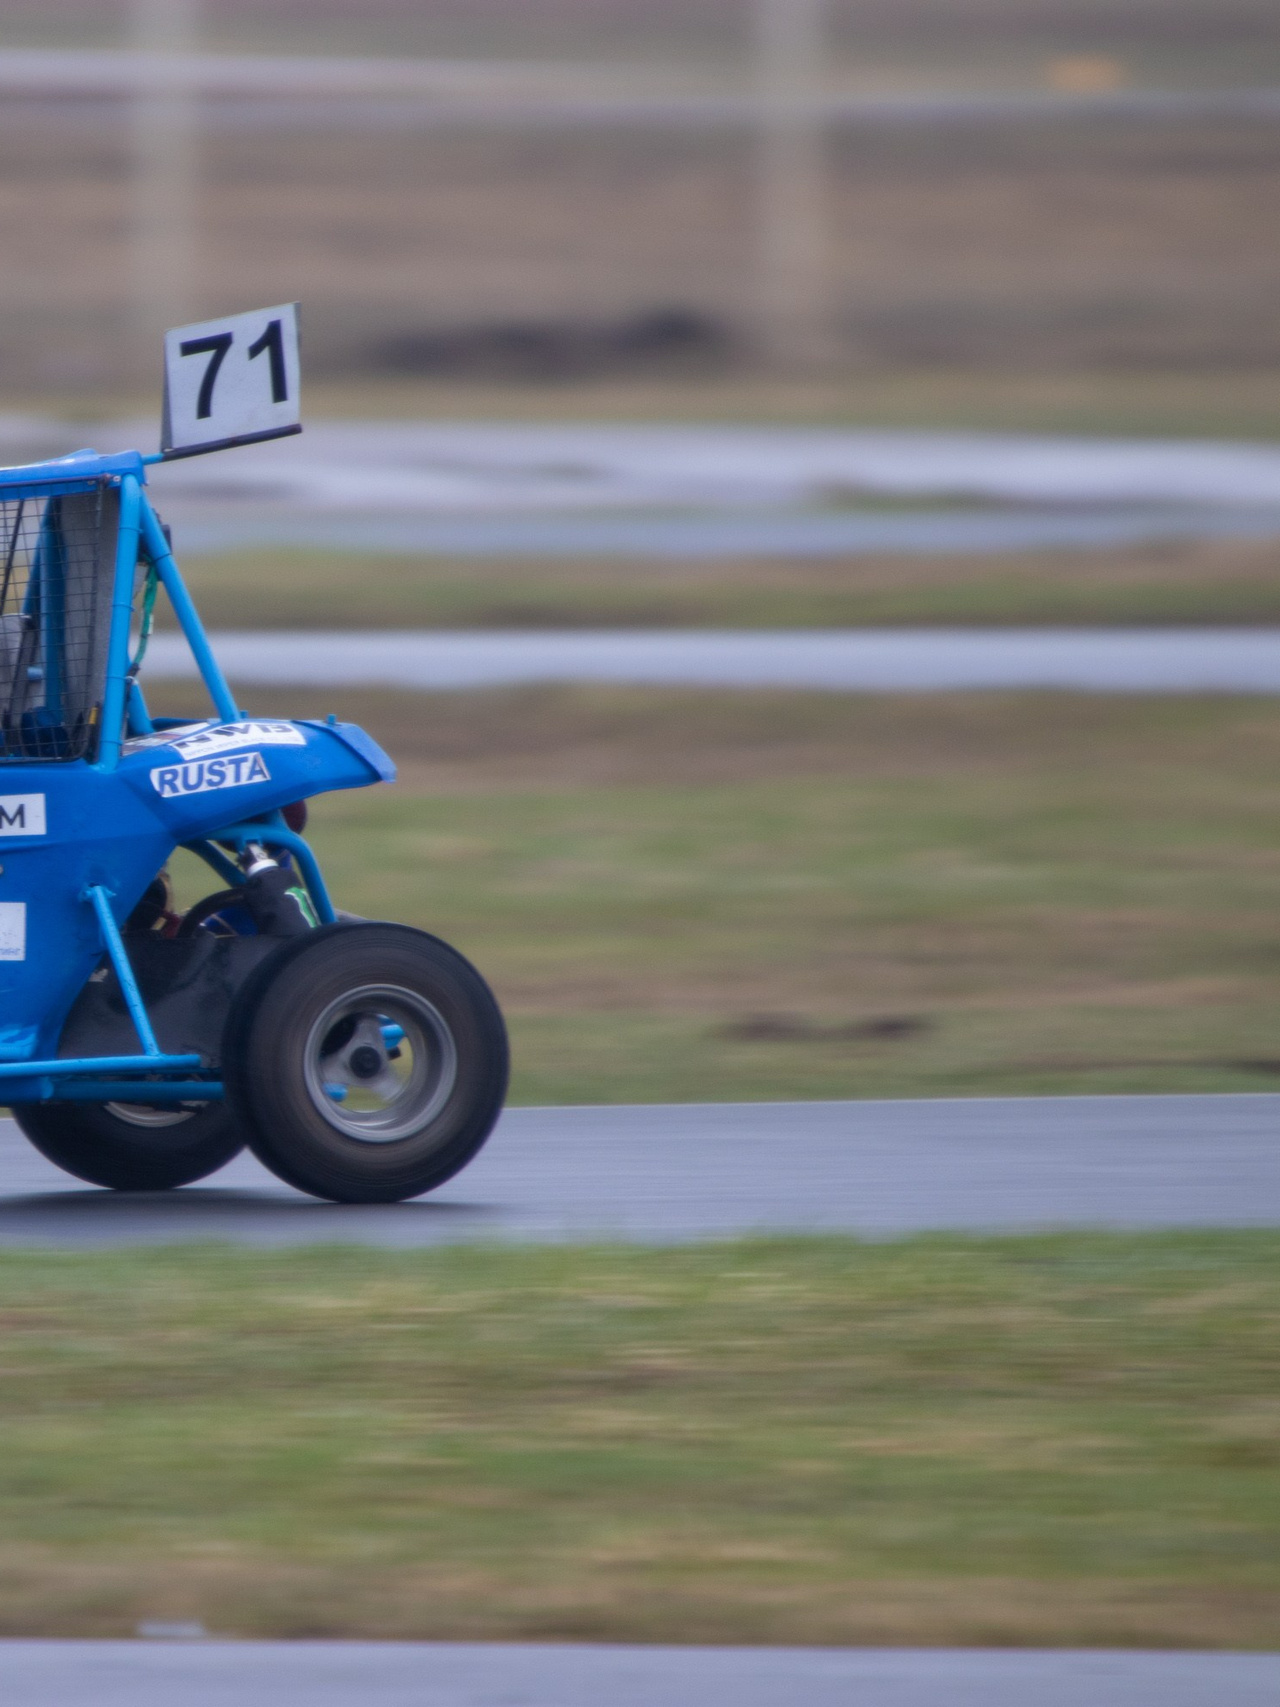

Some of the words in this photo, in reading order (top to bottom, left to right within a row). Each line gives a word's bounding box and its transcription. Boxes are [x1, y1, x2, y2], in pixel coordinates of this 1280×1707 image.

[179, 319, 288, 419] 71
[173, 723, 294, 749] NWB
[158, 756, 268, 795] RUSTA
